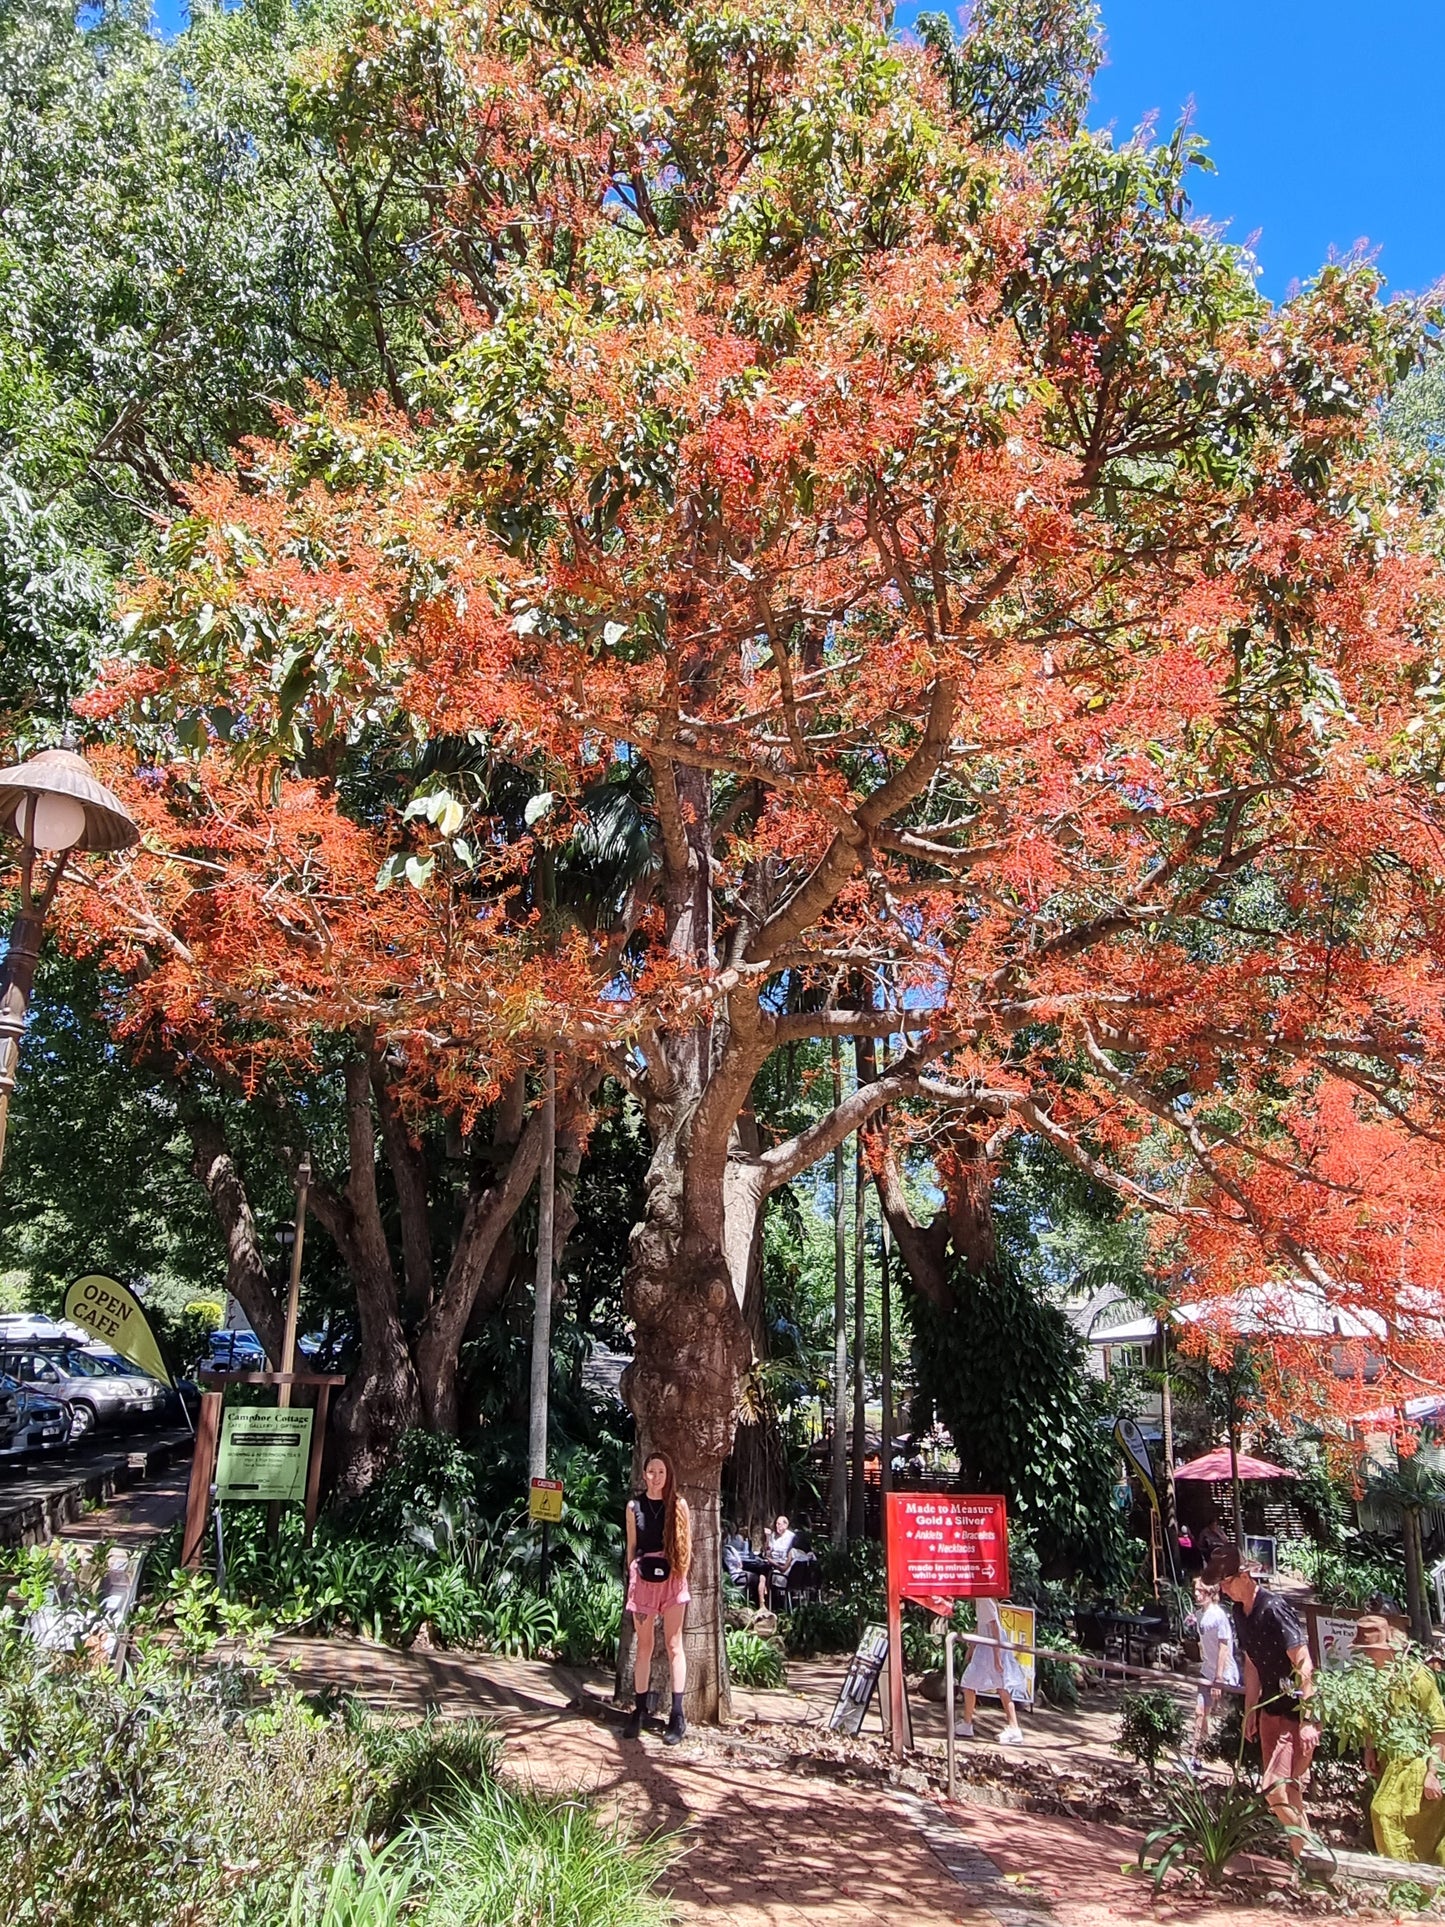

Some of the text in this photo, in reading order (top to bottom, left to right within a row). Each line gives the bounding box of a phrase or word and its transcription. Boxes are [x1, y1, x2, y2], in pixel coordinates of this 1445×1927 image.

[84, 1285, 134, 1321] OPEN
[73, 1302, 120, 1338] CAFE
[227, 1413, 309, 1423] Camphor Cottage
[905, 1503, 994, 1514] Made to Measure
[915, 1516, 985, 1526] Gold & Silver
[914, 1530, 995, 1540] Anklets Bracelets
[937, 1543, 976, 1553] Necklaces
